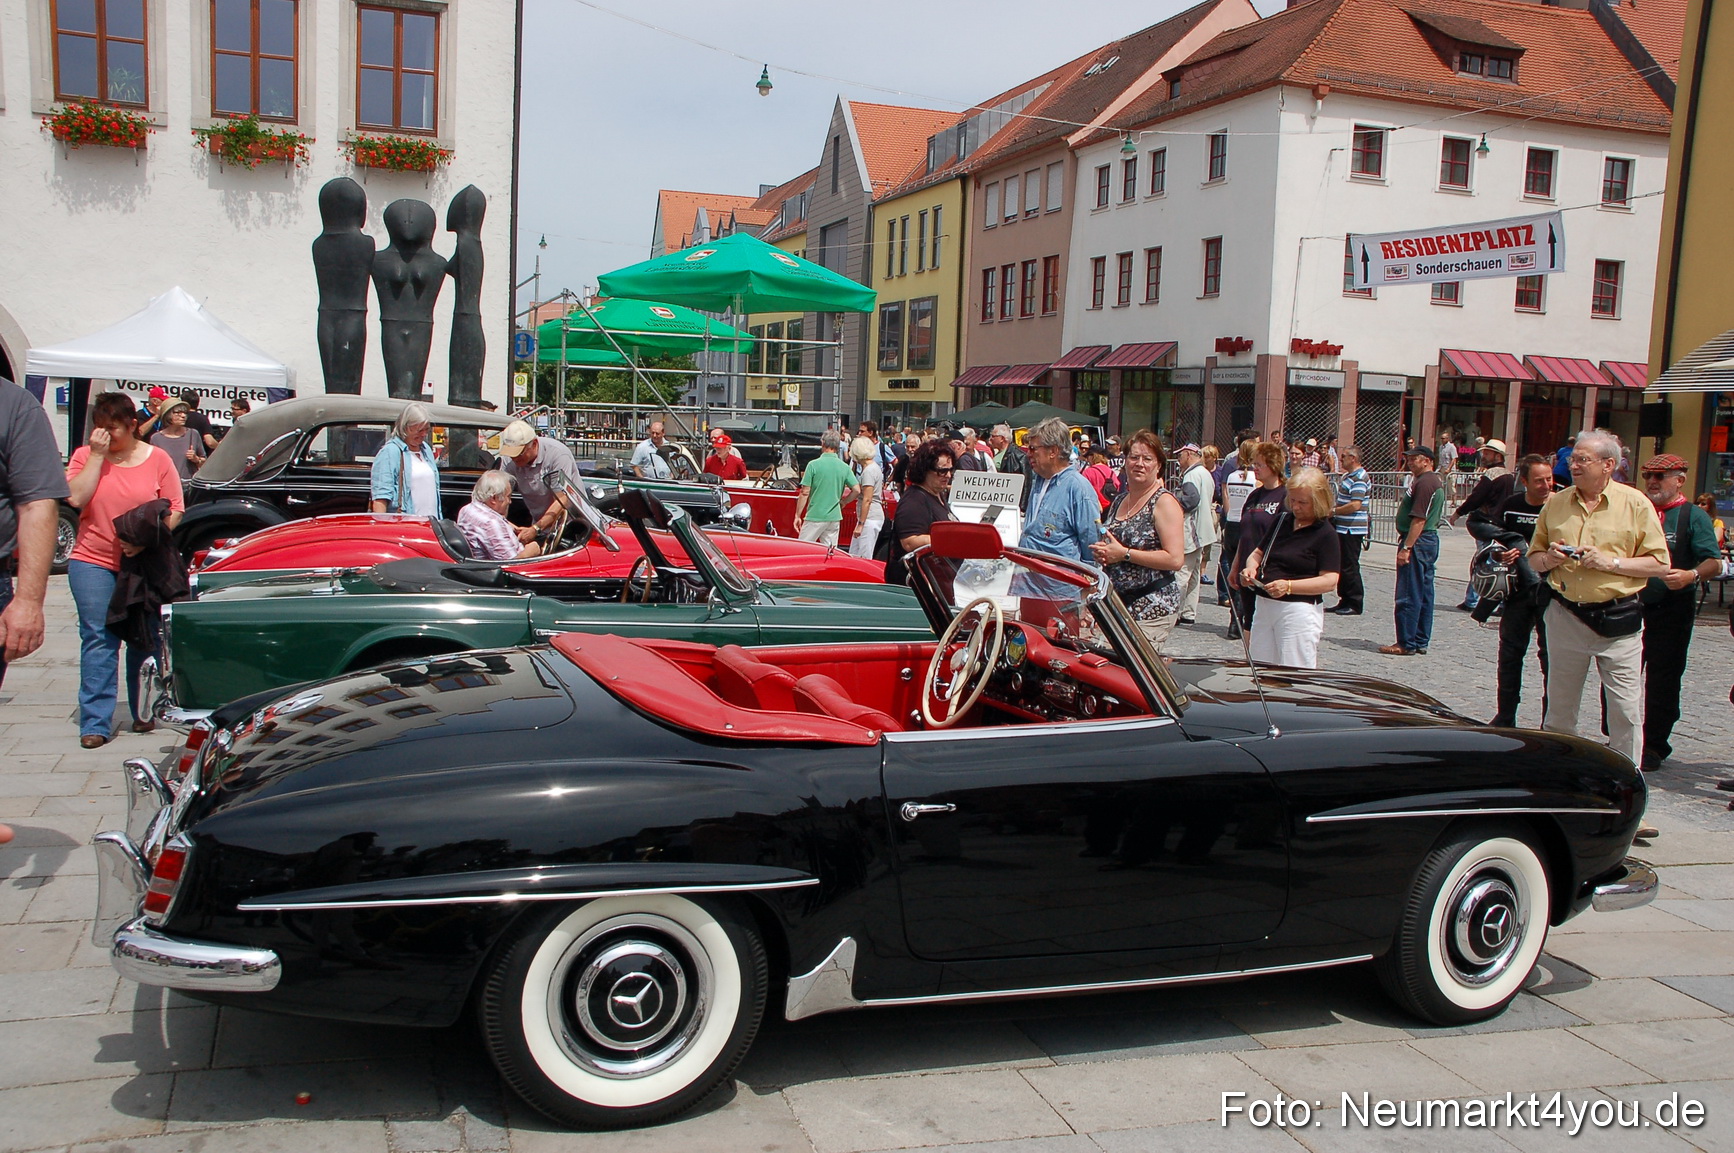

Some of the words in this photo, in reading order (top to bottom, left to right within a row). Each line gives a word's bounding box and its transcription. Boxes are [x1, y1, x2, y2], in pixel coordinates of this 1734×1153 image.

[1380, 224, 1536, 259] RESIDENZPLATZ
[1416, 258, 1502, 275] Sonderschauen
[1291, 338, 1344, 359] Döpfer
[964, 476, 1011, 488] WELTWEIT
[955, 490, 1015, 503] EINZIGARTIG
